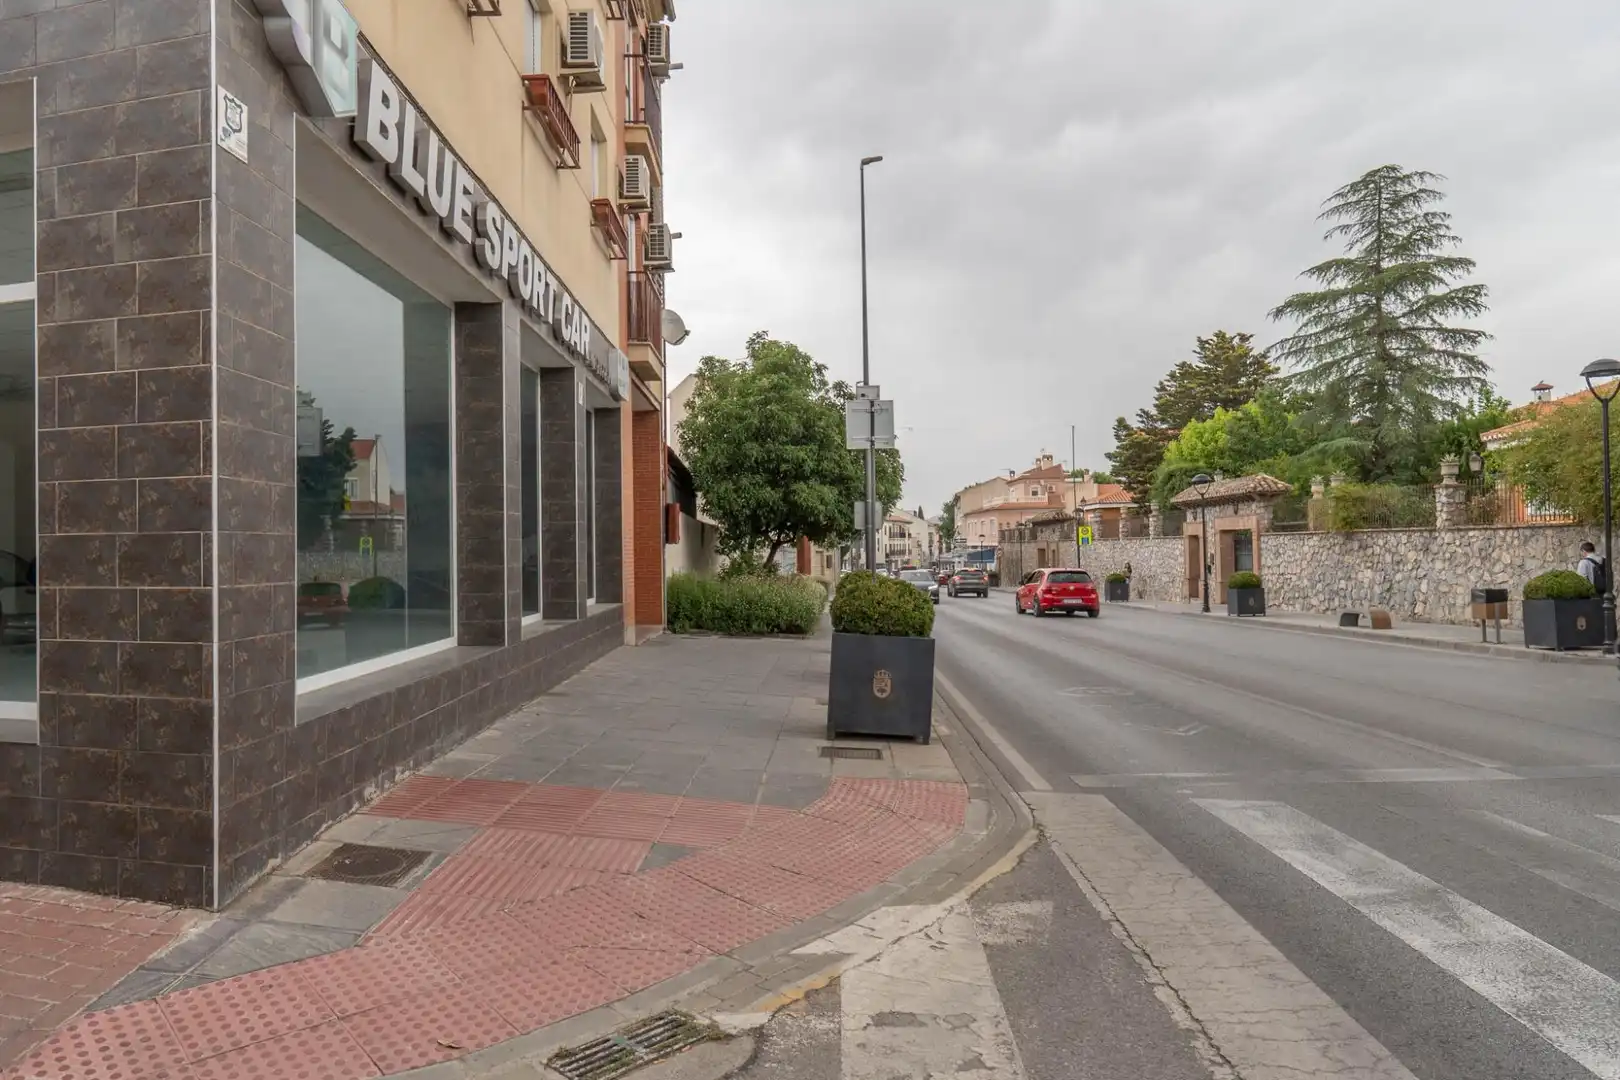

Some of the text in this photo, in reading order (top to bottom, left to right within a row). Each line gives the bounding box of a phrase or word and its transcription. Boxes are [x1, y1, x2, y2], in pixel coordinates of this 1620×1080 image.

[364, 58, 591, 360] BLUE SPORT CAR
